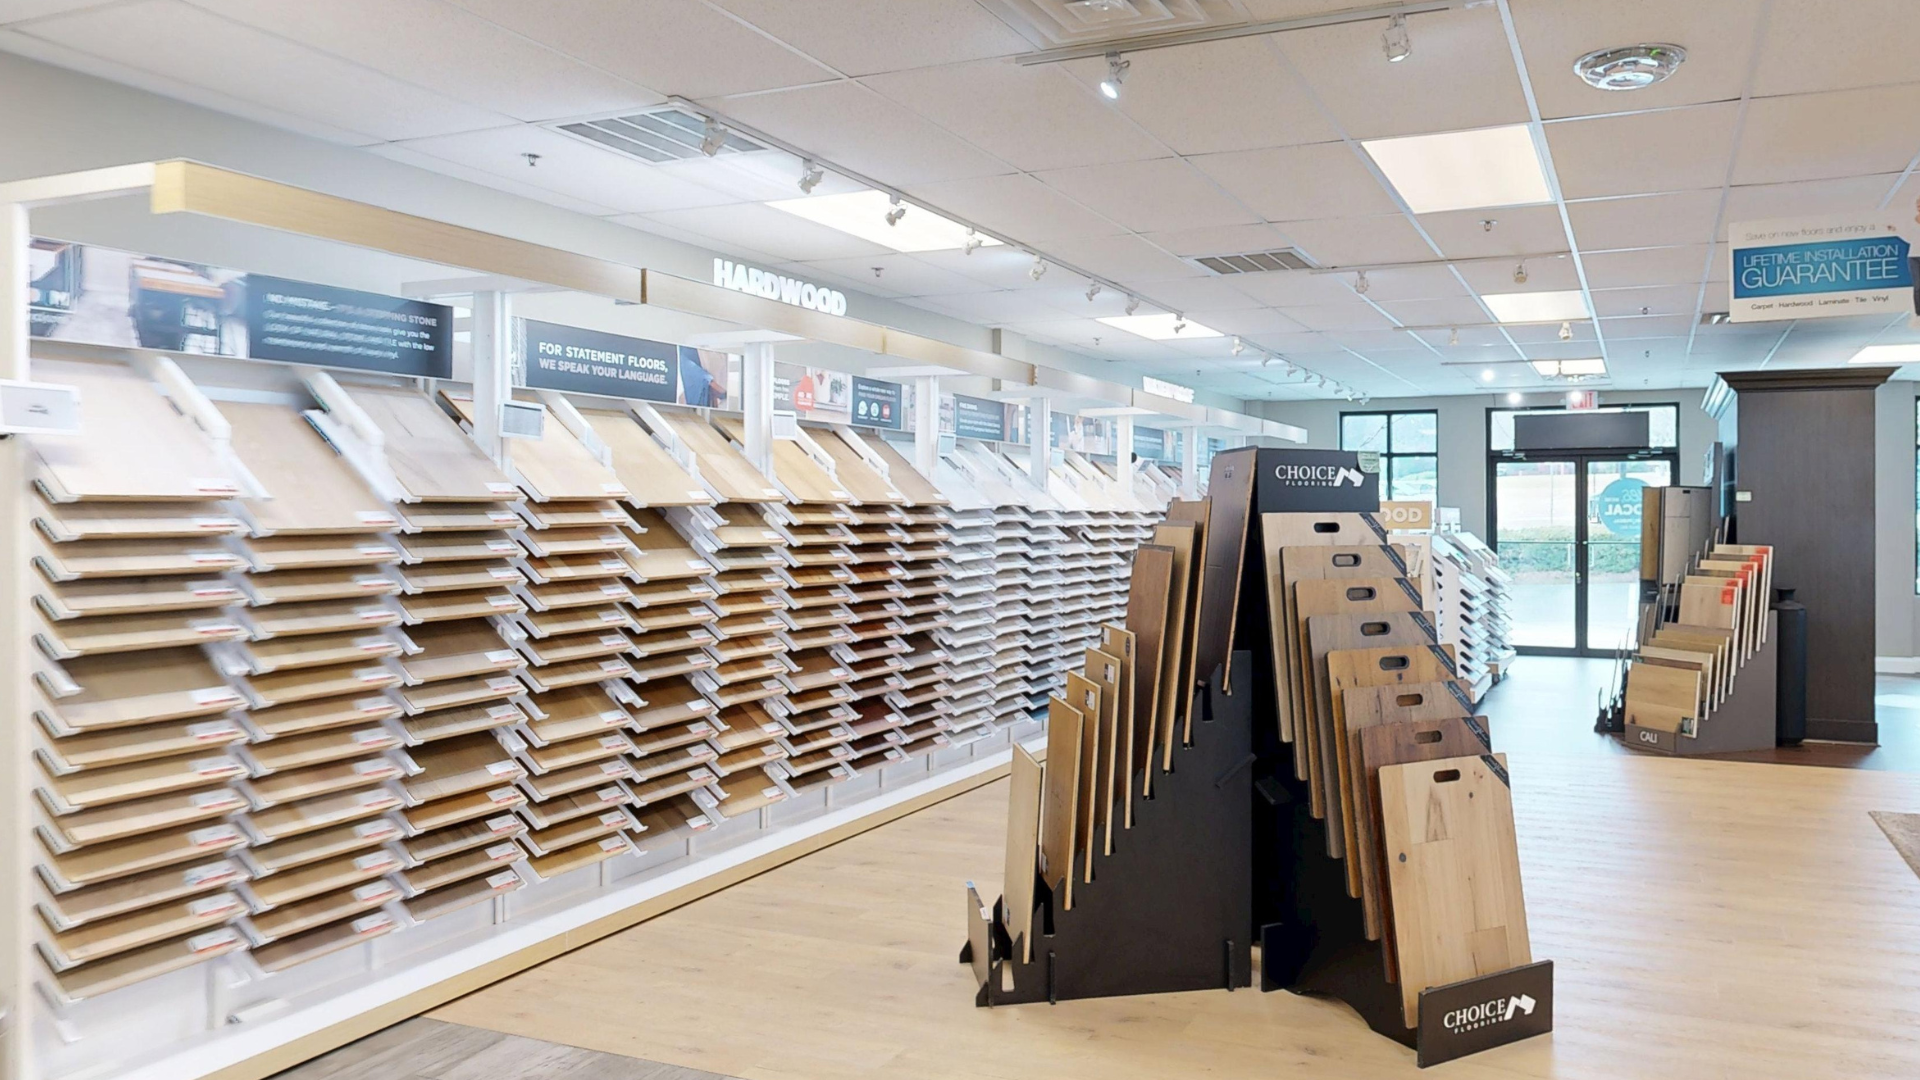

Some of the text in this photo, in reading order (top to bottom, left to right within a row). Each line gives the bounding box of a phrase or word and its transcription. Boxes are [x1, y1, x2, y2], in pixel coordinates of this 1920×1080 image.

[1745, 232, 1767, 241] Save
[1768, 231, 1779, 239] on
[1781, 230, 1799, 238] new
[1801, 228, 1824, 236] floors
[1826, 226, 1842, 234] and
[1844, 224, 1867, 235] enjoy
[1743, 244, 1899, 268] LIFETIME INSTALLATION
[1741, 257, 1900, 289] GUARANTEE
[713, 257, 847, 317] HARDWOOD
[1751, 303, 1774, 311] Carpet
[1778, 300, 1814, 309] Hardwood
[1818, 297, 1850, 306] Laminate
[1872, 295, 1889, 303] Vinyl
[408, 314, 438, 327] STONE
[406, 330, 419, 340] you
[412, 341, 423, 350] the
[538, 341, 669, 373] FOR STATEMENT FLOORS,
[538, 357, 668, 385] WE SPEAK YOUR LANGUAGE.
[1275, 464, 1336, 480] CHOICE
[1640, 730, 1658, 744] CALI
[1443, 998, 1506, 1029] CHOICE
[1454, 1015, 1504, 1035] FLOORING
